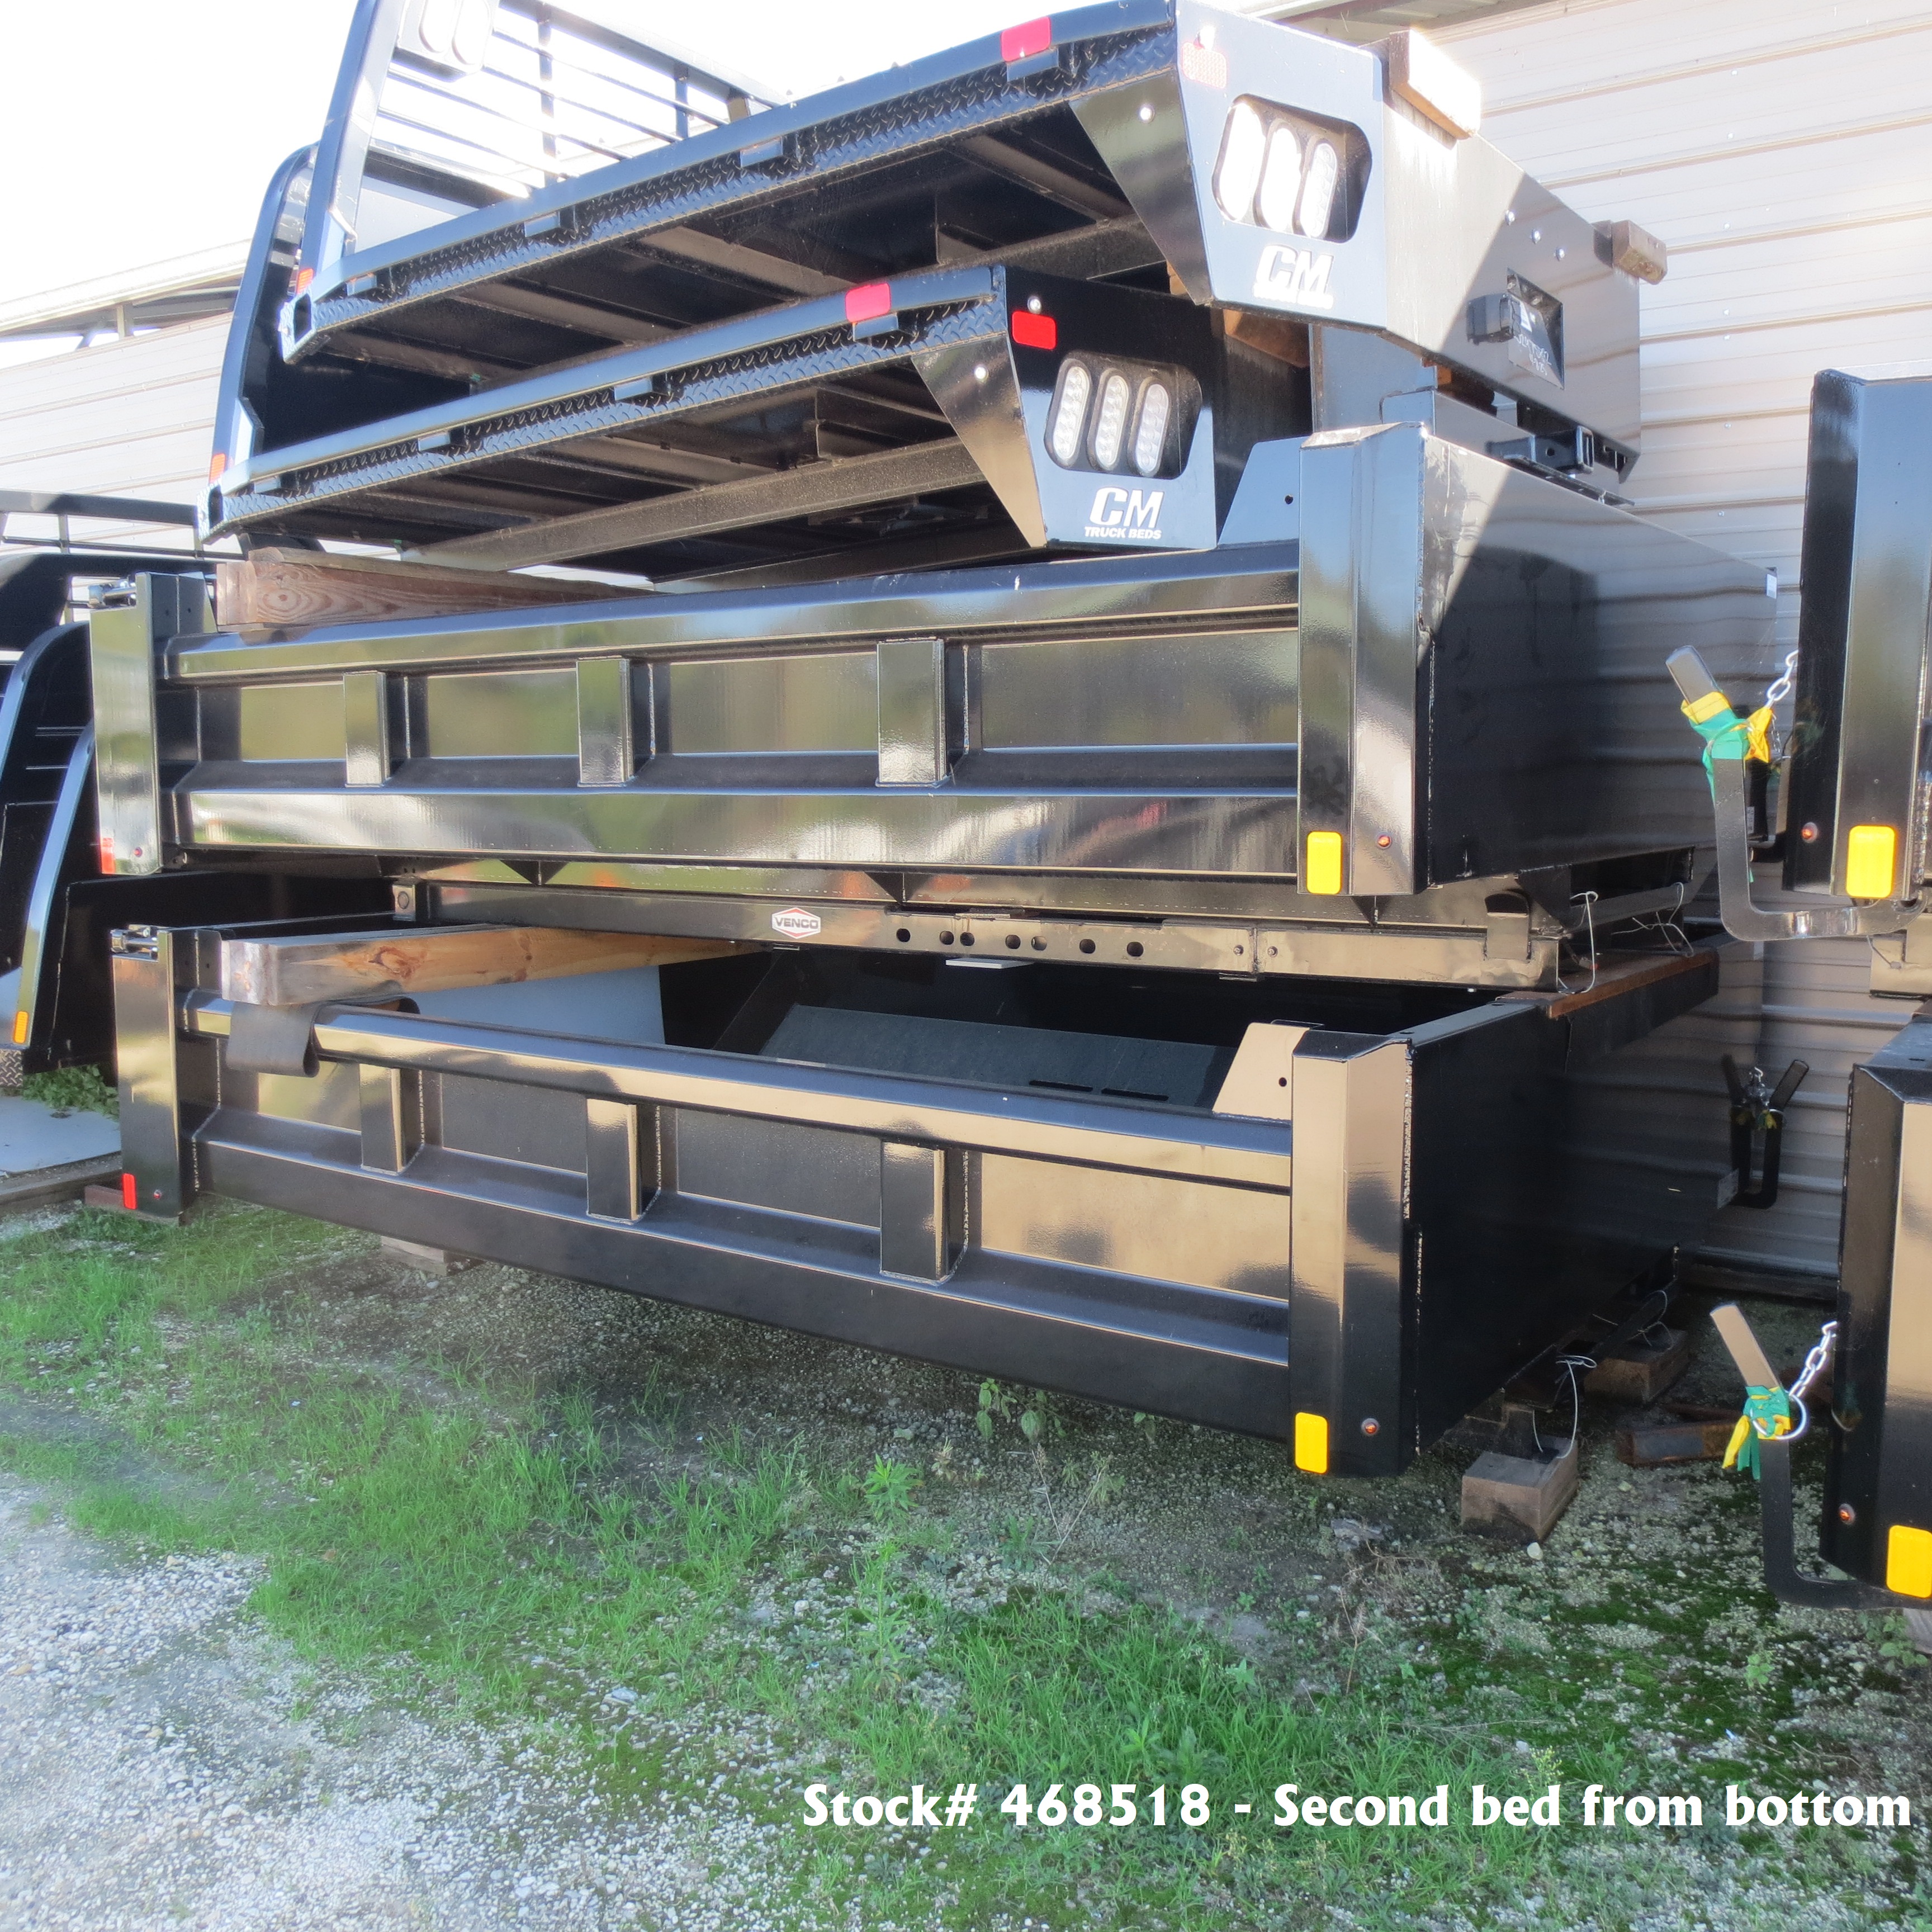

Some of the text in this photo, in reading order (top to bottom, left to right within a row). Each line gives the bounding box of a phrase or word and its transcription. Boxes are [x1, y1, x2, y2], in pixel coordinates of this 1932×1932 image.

[1256, 244, 1334, 294] CM
[1090, 486, 1164, 528] CM
[1085, 526, 1162, 539] TRUCK BEDS
[775, 917, 818, 929] VENCO
